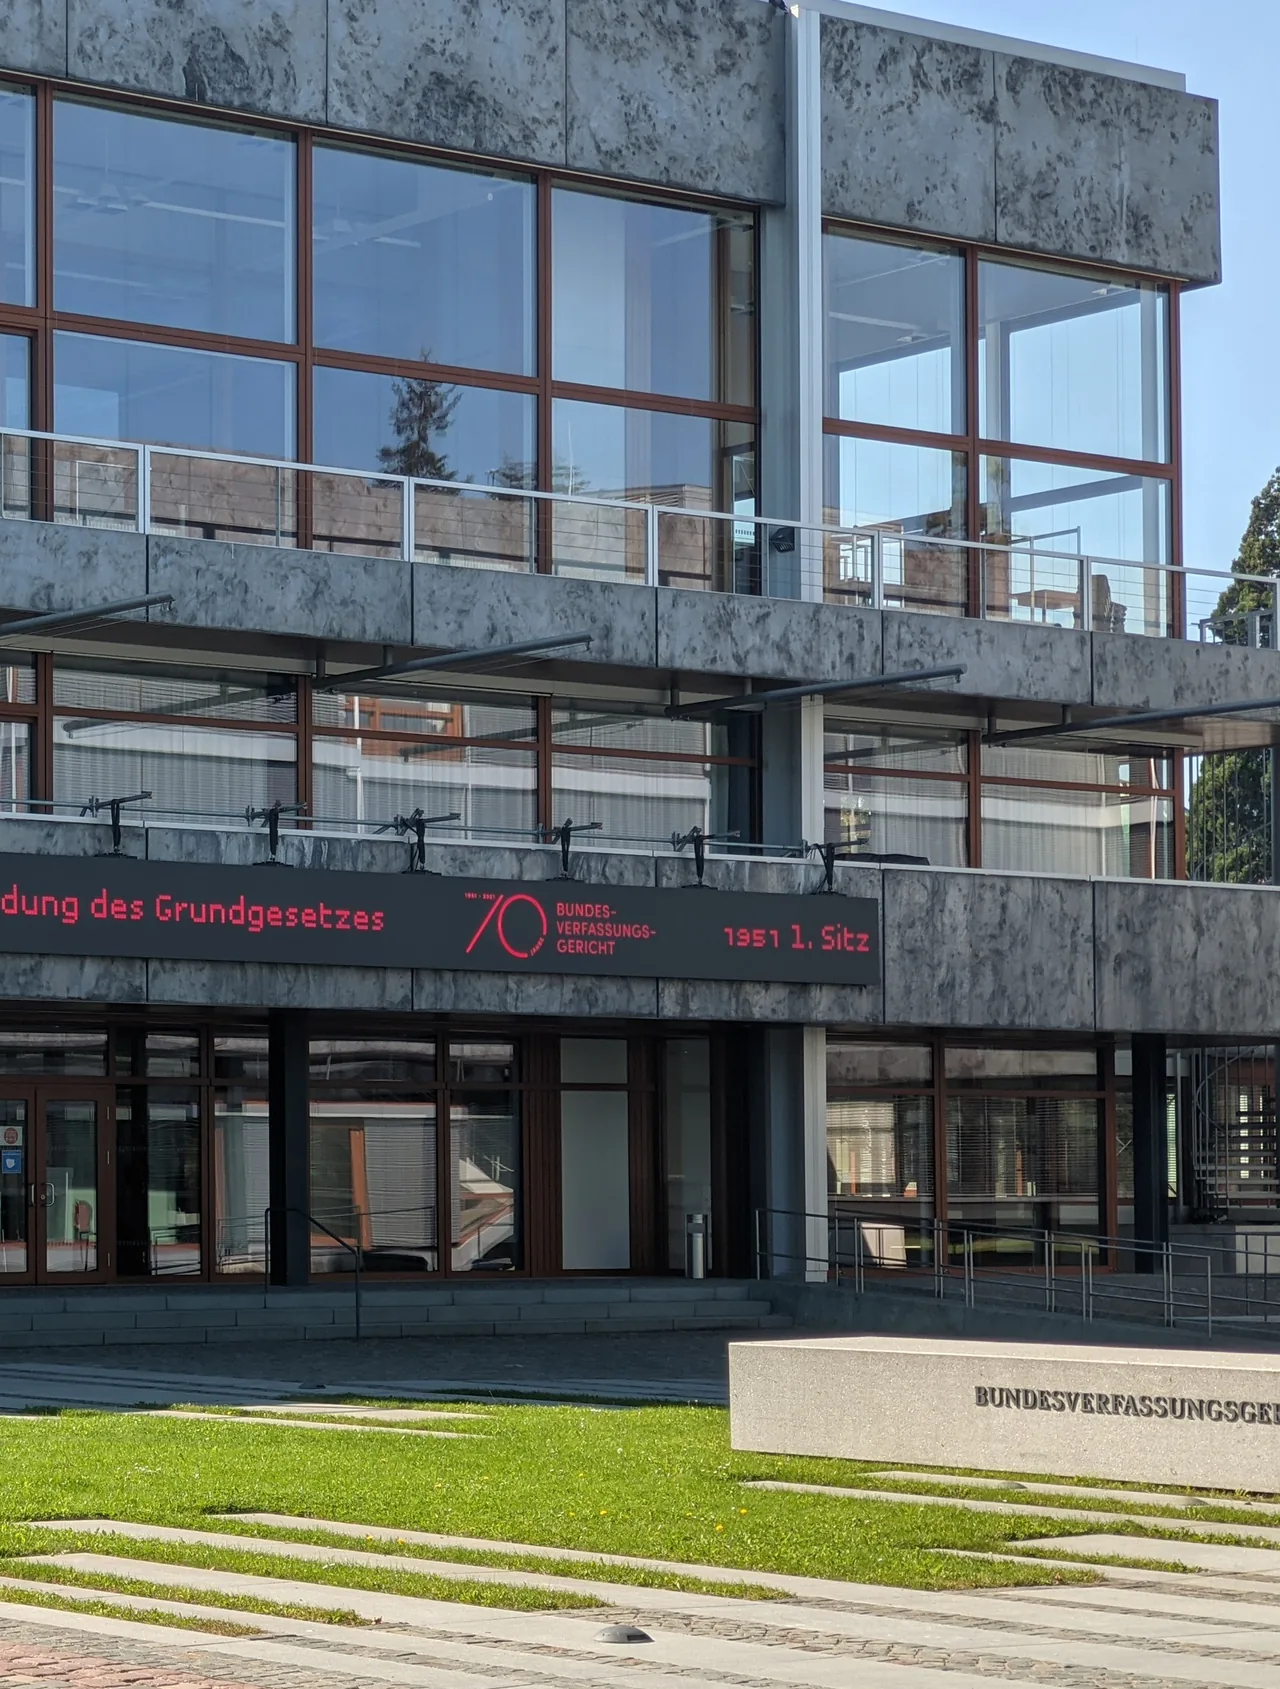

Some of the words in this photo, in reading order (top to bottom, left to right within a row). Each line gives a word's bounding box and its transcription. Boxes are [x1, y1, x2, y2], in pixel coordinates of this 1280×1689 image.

[91, 888, 144, 920] des
[156, 894, 384, 933] Grundgesetzes
[556, 902, 617, 918] BUNDES-
[556, 921, 657, 939] VERFASSUNGS-
[724, 927, 779, 949] 1951
[791, 924, 813, 950] 1.
[821, 922, 870, 952] Sitz
[556, 940, 616, 955] GERICHT
